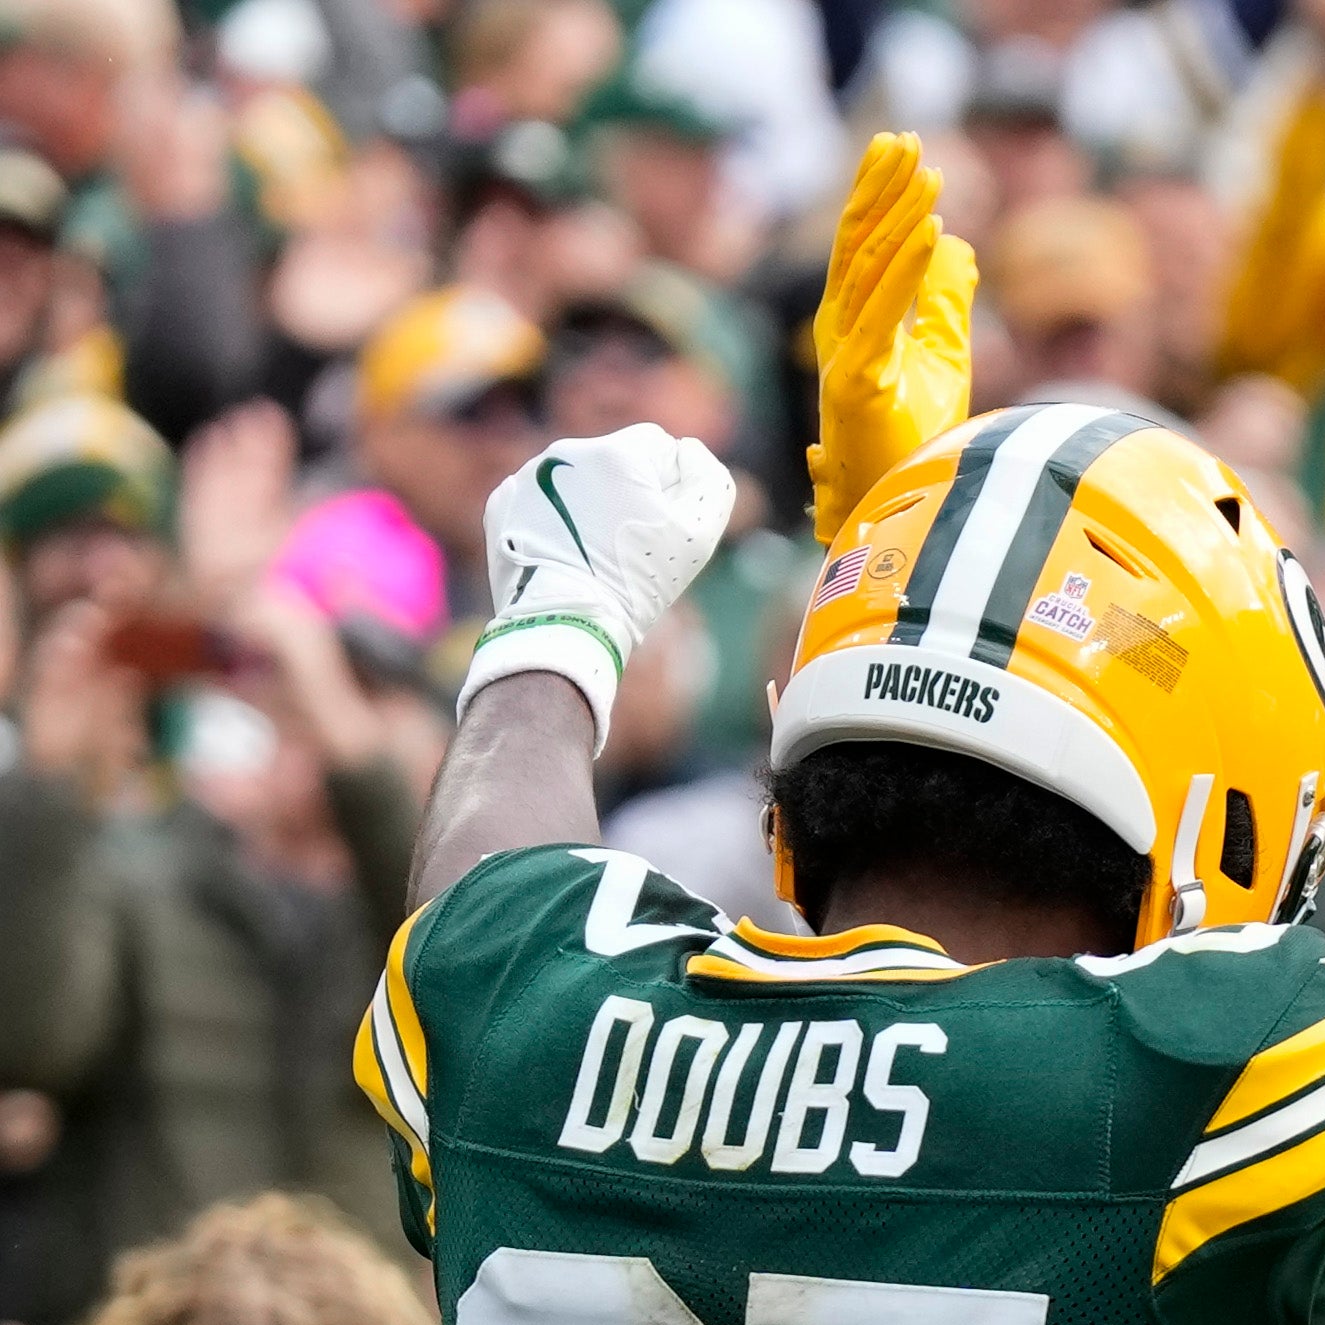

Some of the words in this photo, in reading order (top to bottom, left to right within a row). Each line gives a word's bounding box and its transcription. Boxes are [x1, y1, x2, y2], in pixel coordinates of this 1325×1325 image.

[1034, 600, 1093, 634] CATCH
[1048, 594, 1088, 616] CRUCIAL
[863, 662, 1001, 724] PACKERS
[556, 993, 950, 1180] DOUBS
